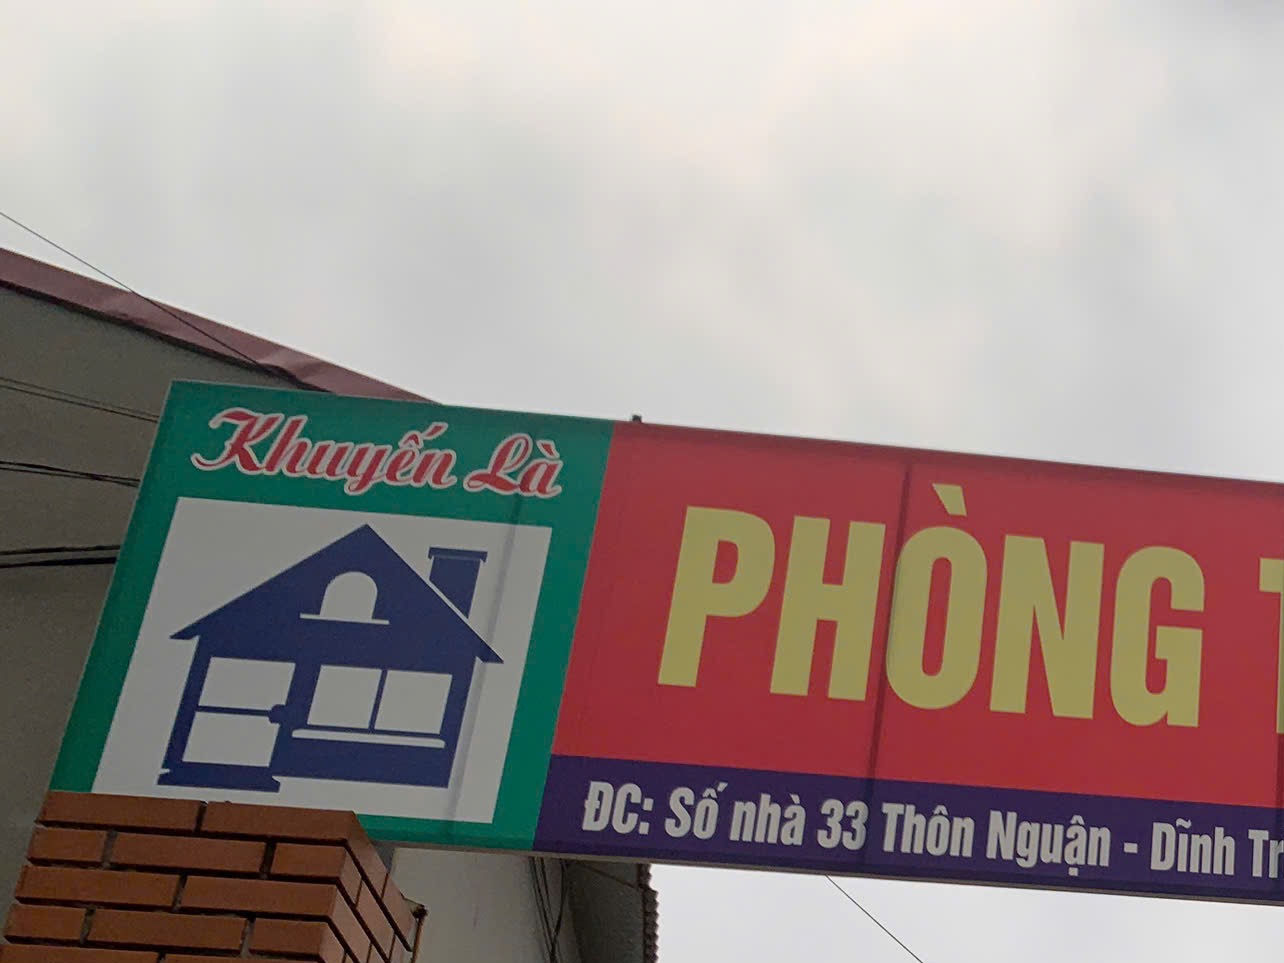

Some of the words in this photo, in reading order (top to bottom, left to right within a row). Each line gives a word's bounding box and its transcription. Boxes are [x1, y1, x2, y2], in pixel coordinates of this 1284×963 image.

[191, 406, 457, 496] Khuyến
[463, 433, 563, 498] Là
[658, 483, 1205, 728] PHÒNG
[582, 780, 654, 836] ĐC:
[664, 781, 728, 840] Số
[729, 793, 806, 846] nhà
[817, 798, 869, 850] 33
[881, 802, 975, 858] Thôn
[986, 810, 1111, 877] Nguận
[1123, 842, 1138, 854] -
[1150, 818, 1236, 876] Dĩnh
